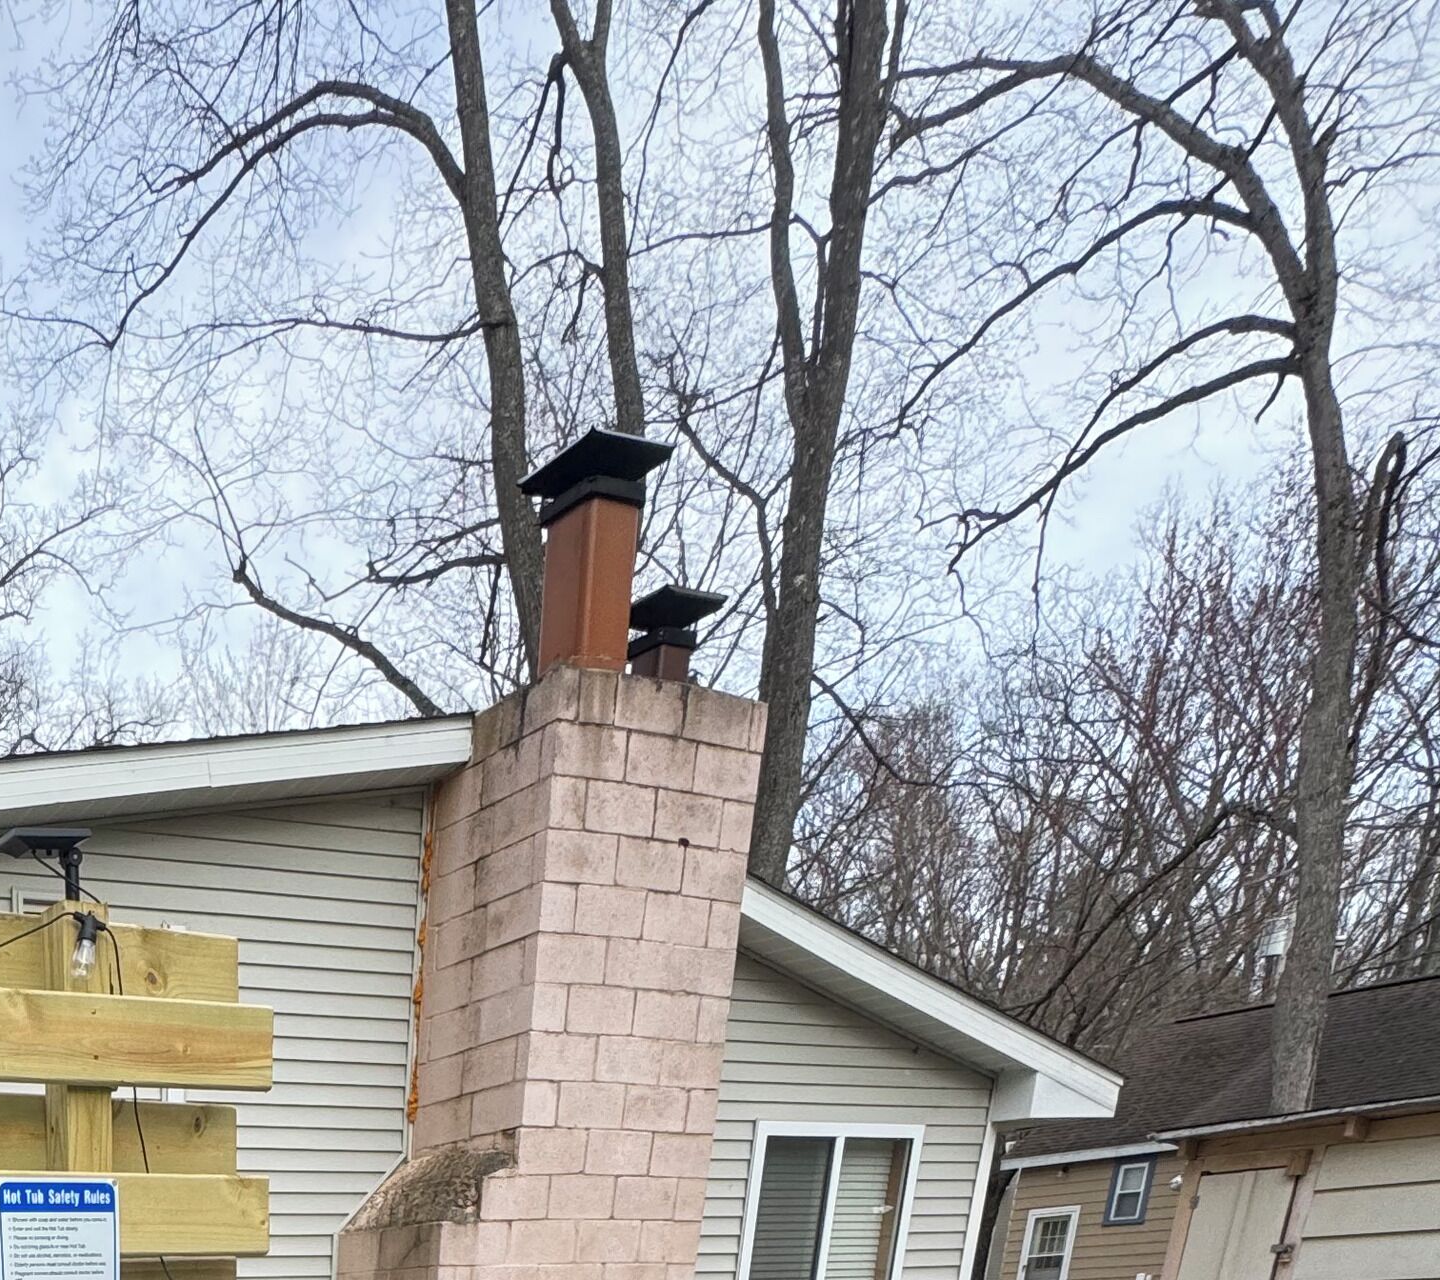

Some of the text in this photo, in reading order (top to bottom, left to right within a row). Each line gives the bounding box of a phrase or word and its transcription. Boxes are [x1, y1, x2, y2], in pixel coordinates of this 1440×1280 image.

[3, 1189, 111, 1208] Hot Tub Safety Rules
